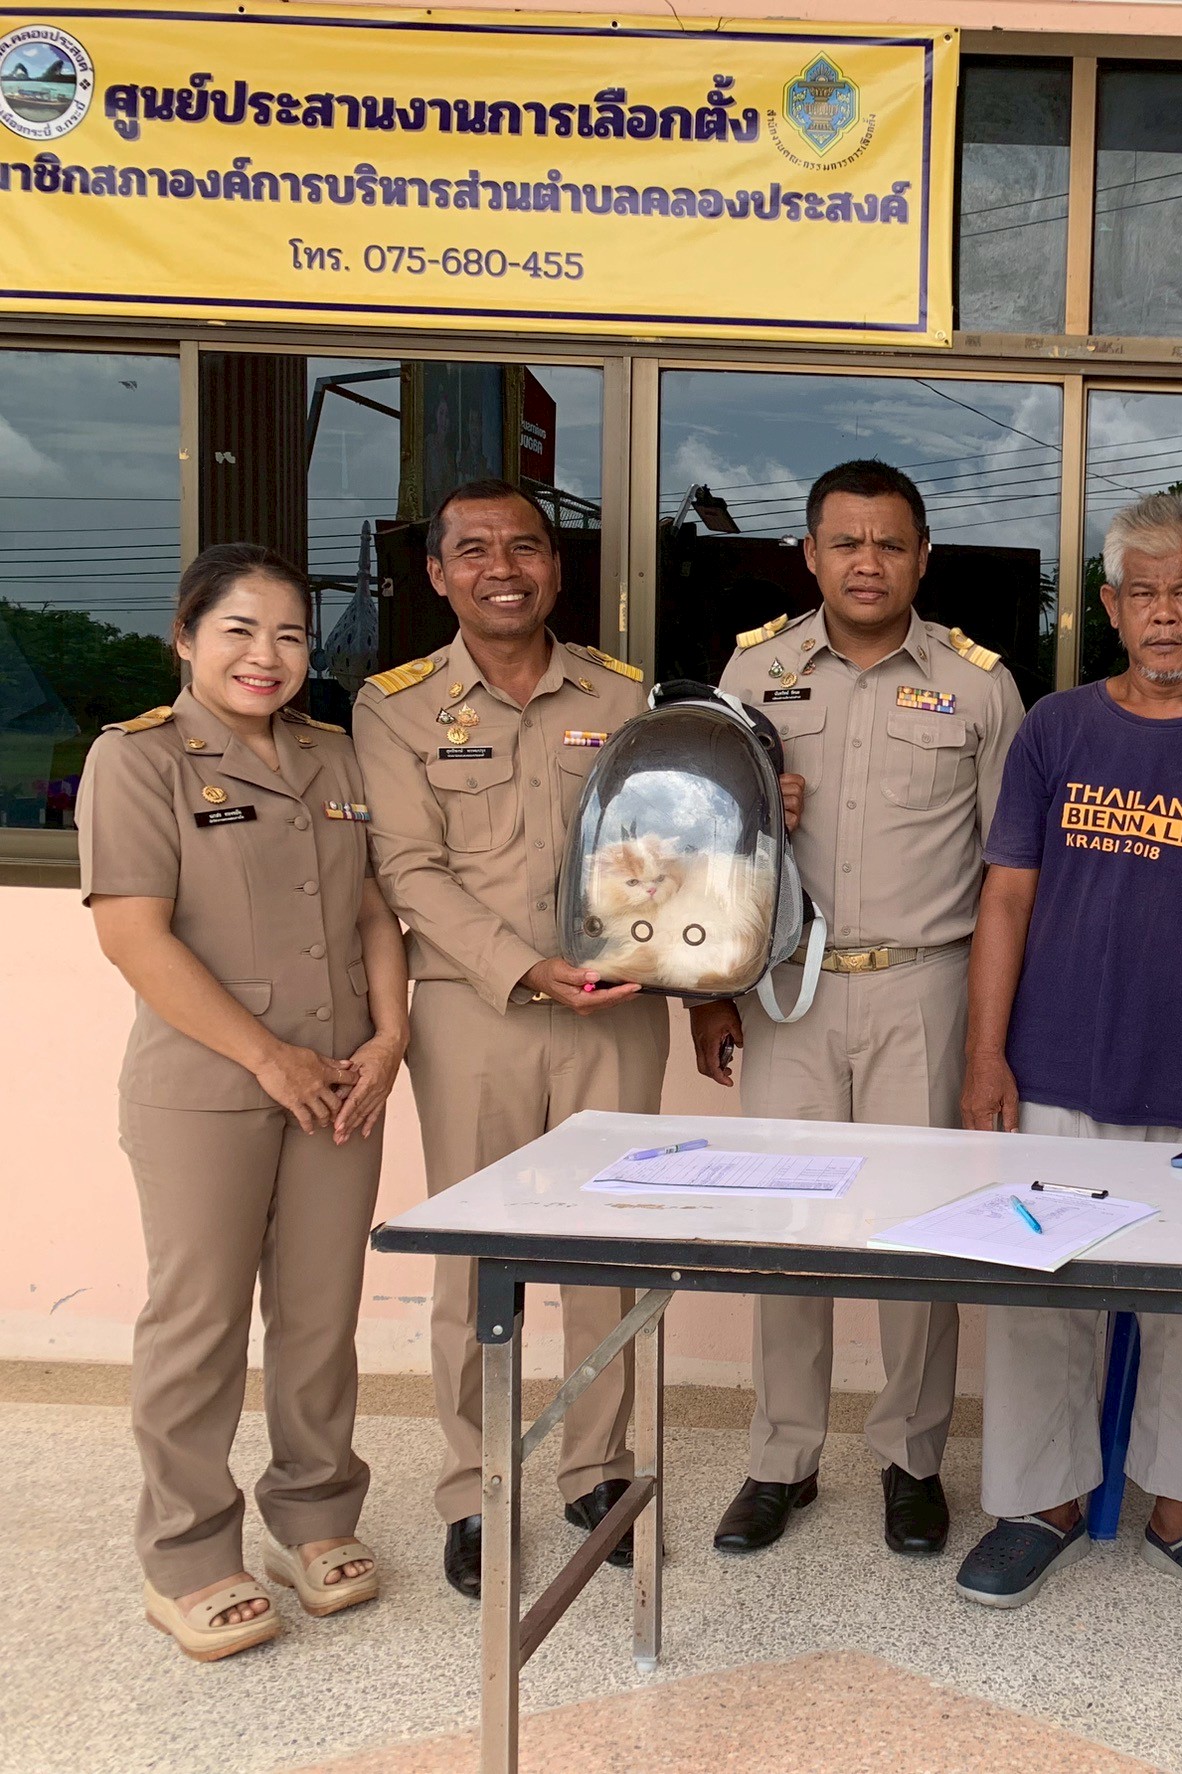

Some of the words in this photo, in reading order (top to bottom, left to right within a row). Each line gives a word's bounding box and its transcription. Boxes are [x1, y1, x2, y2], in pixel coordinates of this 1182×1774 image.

[104, 72, 760, 143] ศูนย์ประสานงานการเลือกตั้ง
[288, 238, 350, 273] โทร.
[363, 244, 584, 280] 075-680-455
[1066, 833, 1120, 853] KRABI
[1123, 839, 1161, 860] 2018
